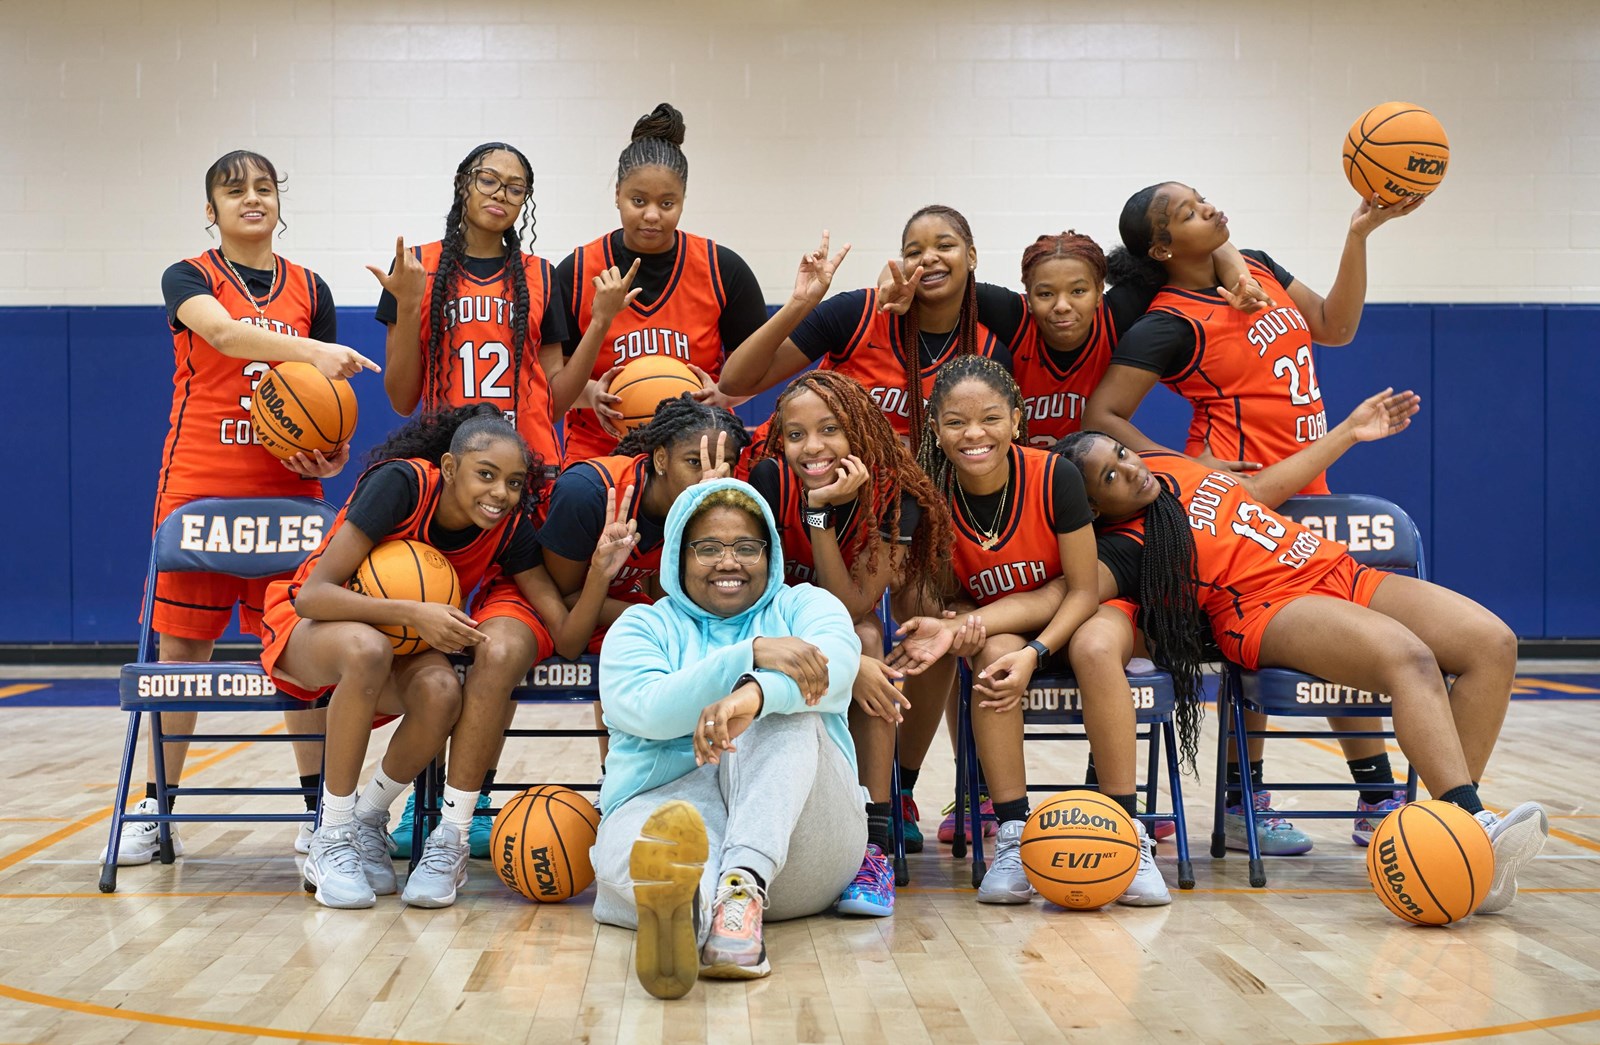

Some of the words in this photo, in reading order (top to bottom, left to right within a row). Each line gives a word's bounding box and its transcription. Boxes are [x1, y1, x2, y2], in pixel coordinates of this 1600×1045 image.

[612, 327, 691, 366] SOUTH
[1246, 306, 1310, 359] SOUTH
[239, 360, 273, 411] 3
[458, 340, 512, 399] 12
[1272, 343, 1322, 407] 22
[259, 376, 304, 441] Wilson
[1188, 471, 1239, 537] SOUTH
[1231, 501, 1288, 554] 13
[179, 514, 325, 554] EAGLES
[968, 560, 1048, 601] SOUTH
[137, 674, 213, 698] SOUTH
[217, 673, 277, 697] COBB
[532, 663, 593, 687] COBB
[1038, 807, 1118, 834] Wilson
[531, 846, 559, 897] NCAA
[1051, 851, 1102, 869] EVO
[1102, 851, 1118, 859] NXT
[1378, 835, 1424, 917] Wilson
